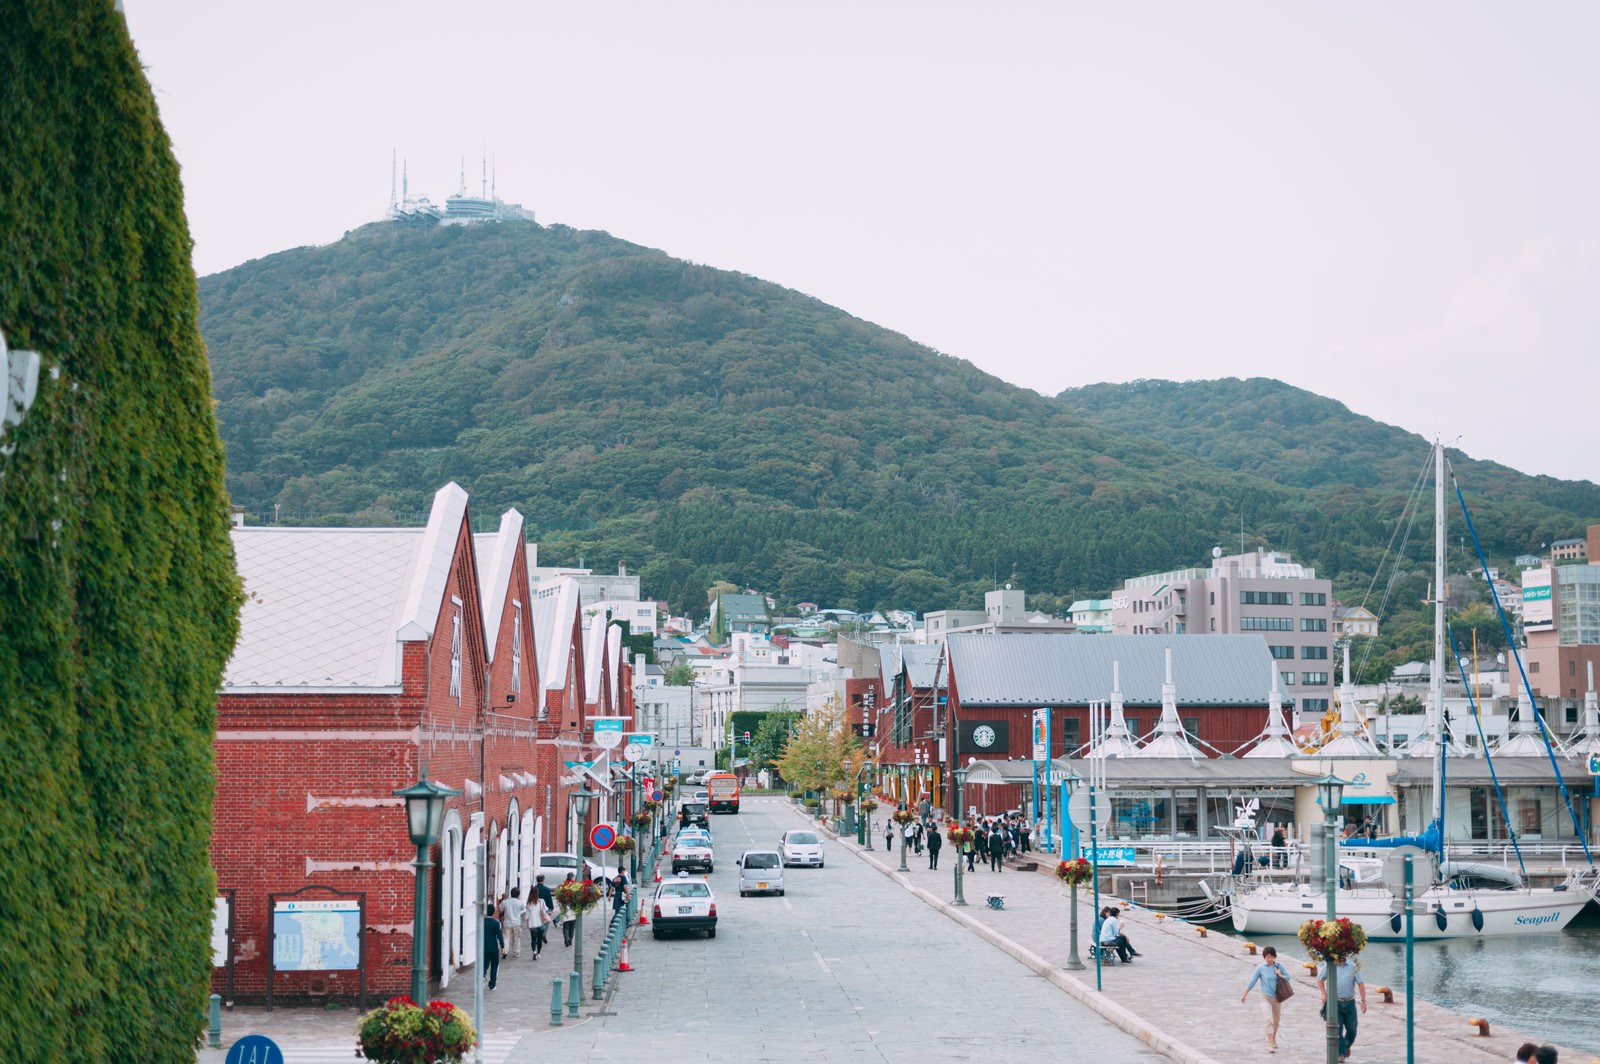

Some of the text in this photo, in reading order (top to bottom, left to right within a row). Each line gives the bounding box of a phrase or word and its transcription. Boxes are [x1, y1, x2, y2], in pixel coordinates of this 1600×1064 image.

[1084, 849, 1123, 859] チット売場
[1514, 912, 1560, 926] Seagull
